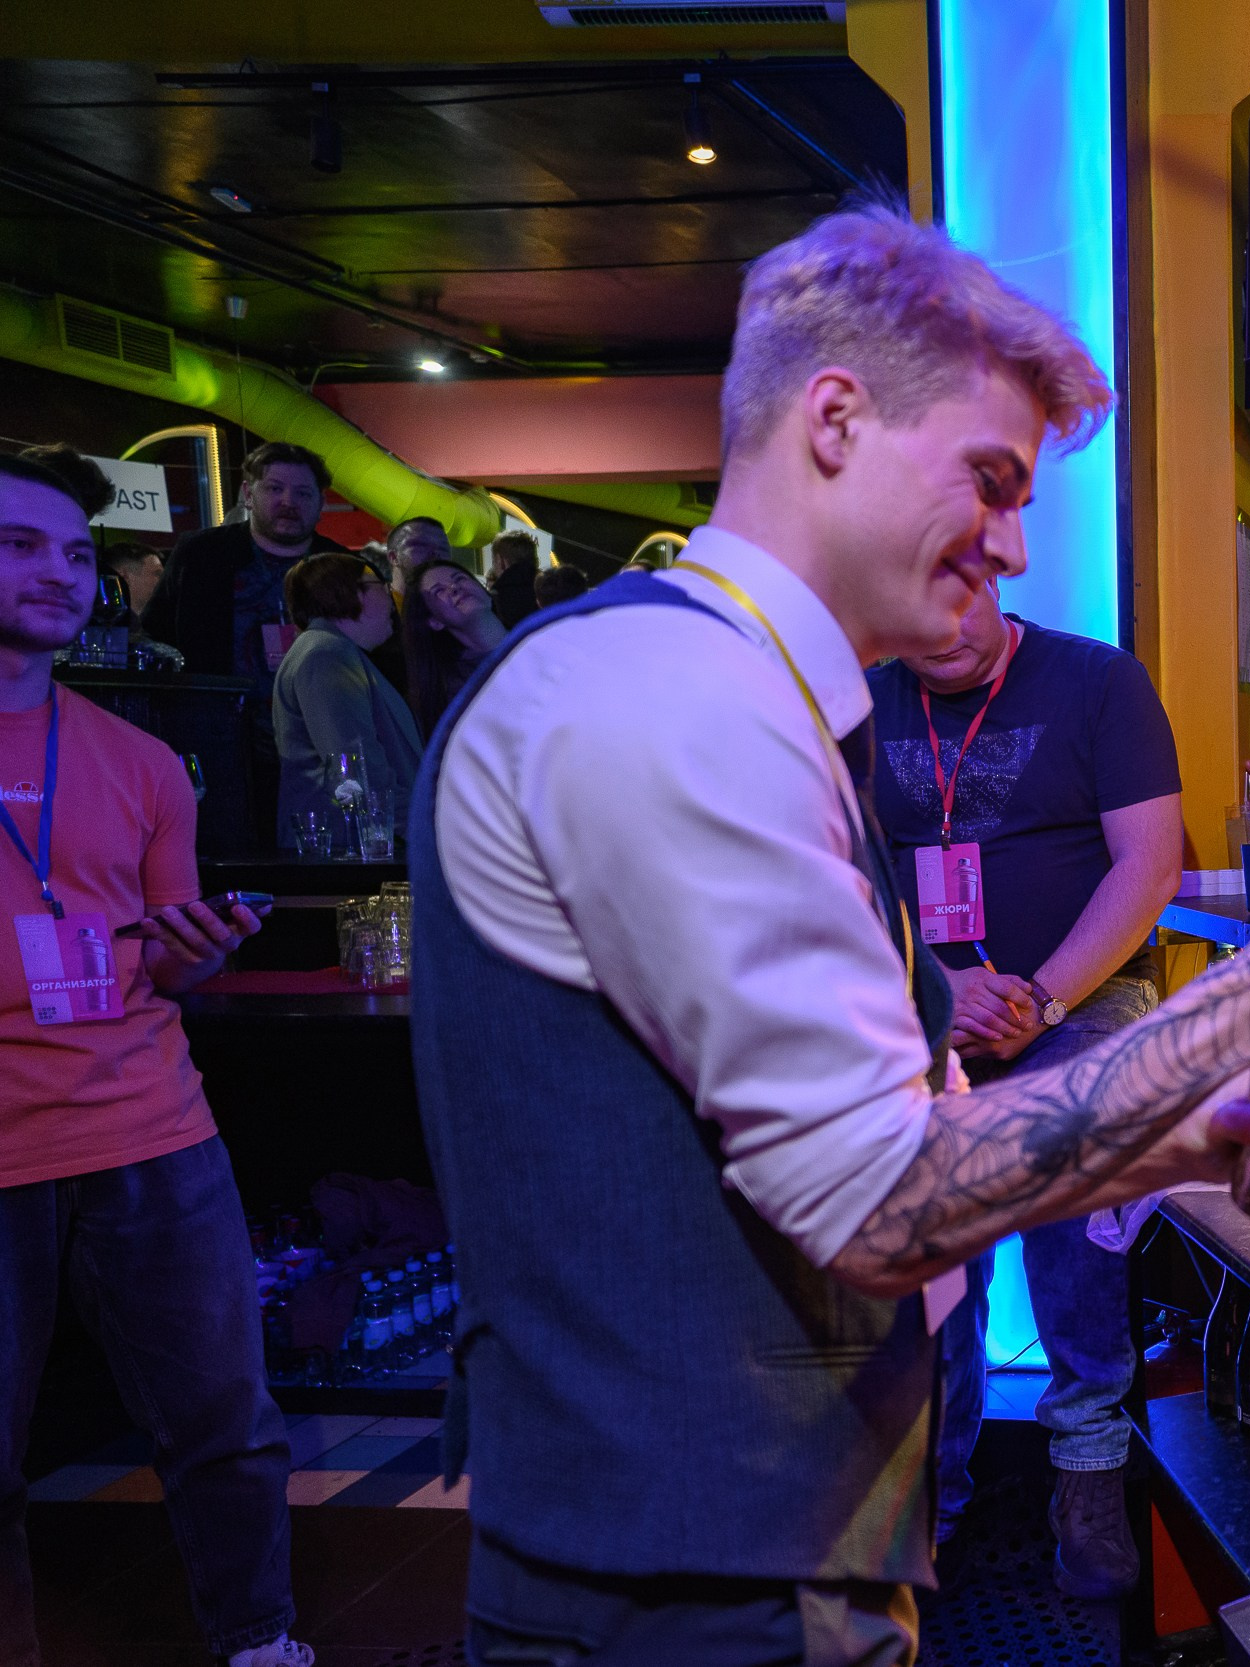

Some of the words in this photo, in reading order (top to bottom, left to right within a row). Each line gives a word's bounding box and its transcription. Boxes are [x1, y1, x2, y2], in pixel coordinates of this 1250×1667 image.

[116, 488, 160, 512] AST
[934, 903, 970, 915] ЖЮРИ
[31, 978, 116, 991] ОРГАНИЗАТОР
